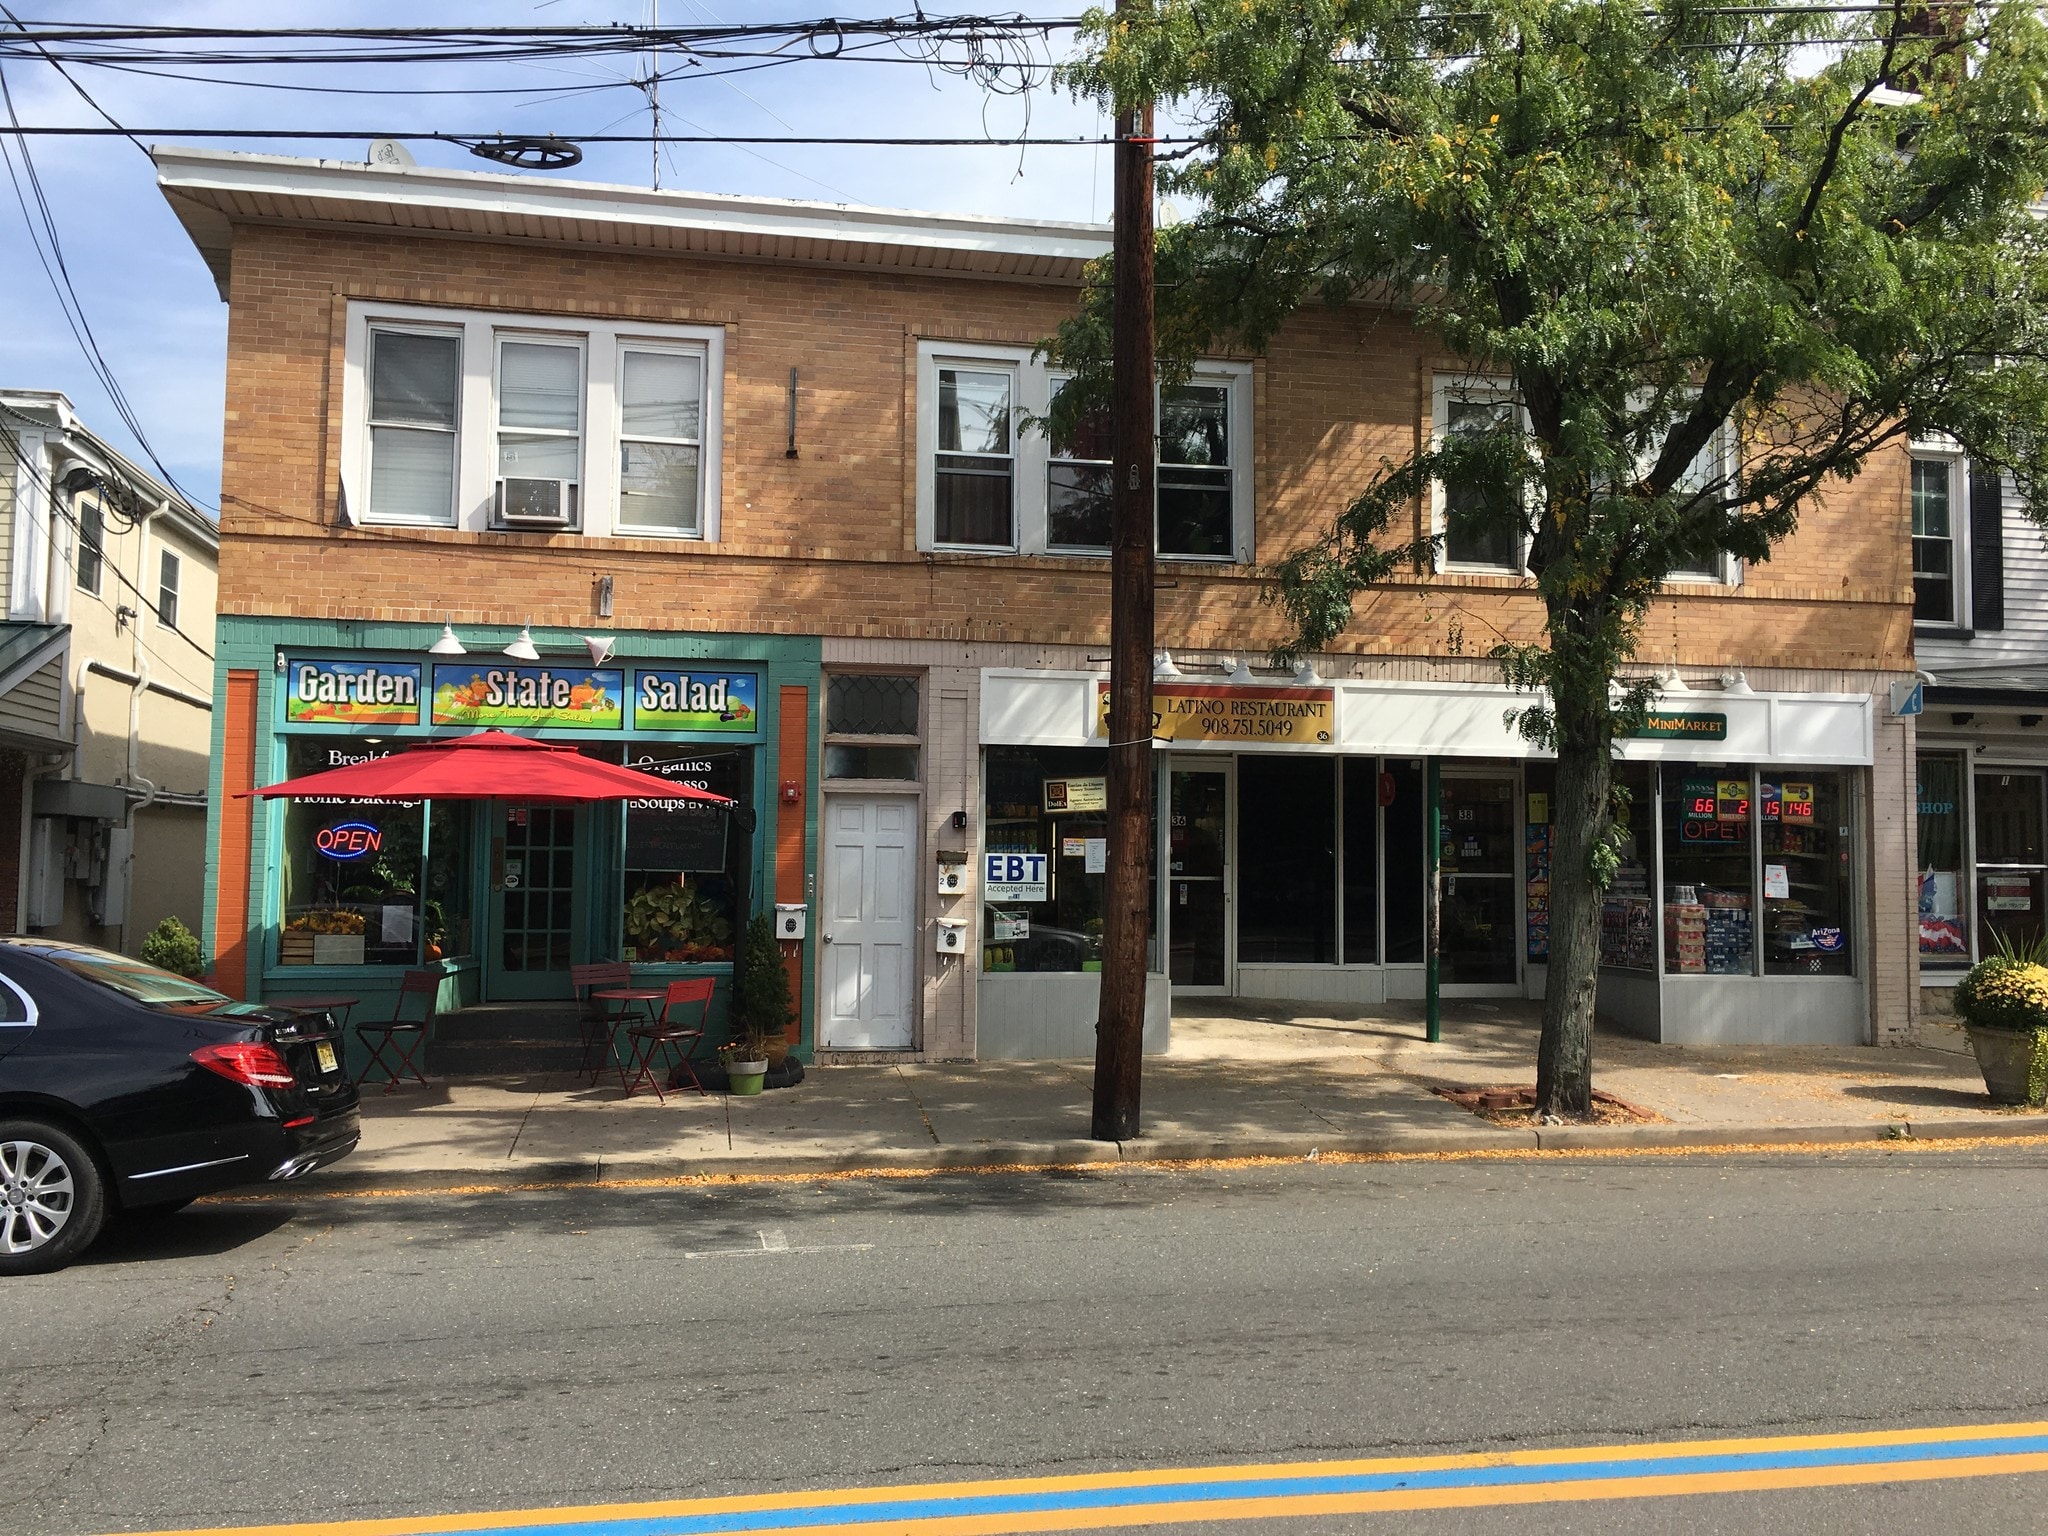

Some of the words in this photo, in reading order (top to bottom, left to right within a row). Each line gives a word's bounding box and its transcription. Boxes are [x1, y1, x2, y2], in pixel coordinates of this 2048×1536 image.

[299, 665, 417, 705] Garden
[486, 670, 570, 708] State
[642, 675, 727, 711] Salad
[1168, 698, 1225, 715] LATINO
[1230, 701, 1327, 718] RESTAURANT
[461, 709, 497, 719] More
[500, 708, 529, 718] Than
[530, 709, 556, 722] Just
[559, 711, 593, 723] Salad
[1201, 717, 1293, 737] 908.751.5049
[1318, 732, 1328, 740] 36
[328, 749, 390, 767] Breakf
[637, 799, 686, 812] Soups
[1695, 798, 1714, 813] 66
[1738, 800, 1749, 814] 2
[1766, 801, 1780, 815] 15
[1788, 802, 1812, 816] 146
[1172, 816, 1185, 826] 36
[1459, 810, 1472, 820] 38
[1684, 821, 1748, 839] OPEN
[317, 829, 382, 851] OPEN
[988, 855, 1046, 882] EBT
[940, 877, 945, 885] 2
[987, 885, 1024, 894] Accepted
[1025, 885, 1045, 893] Here
